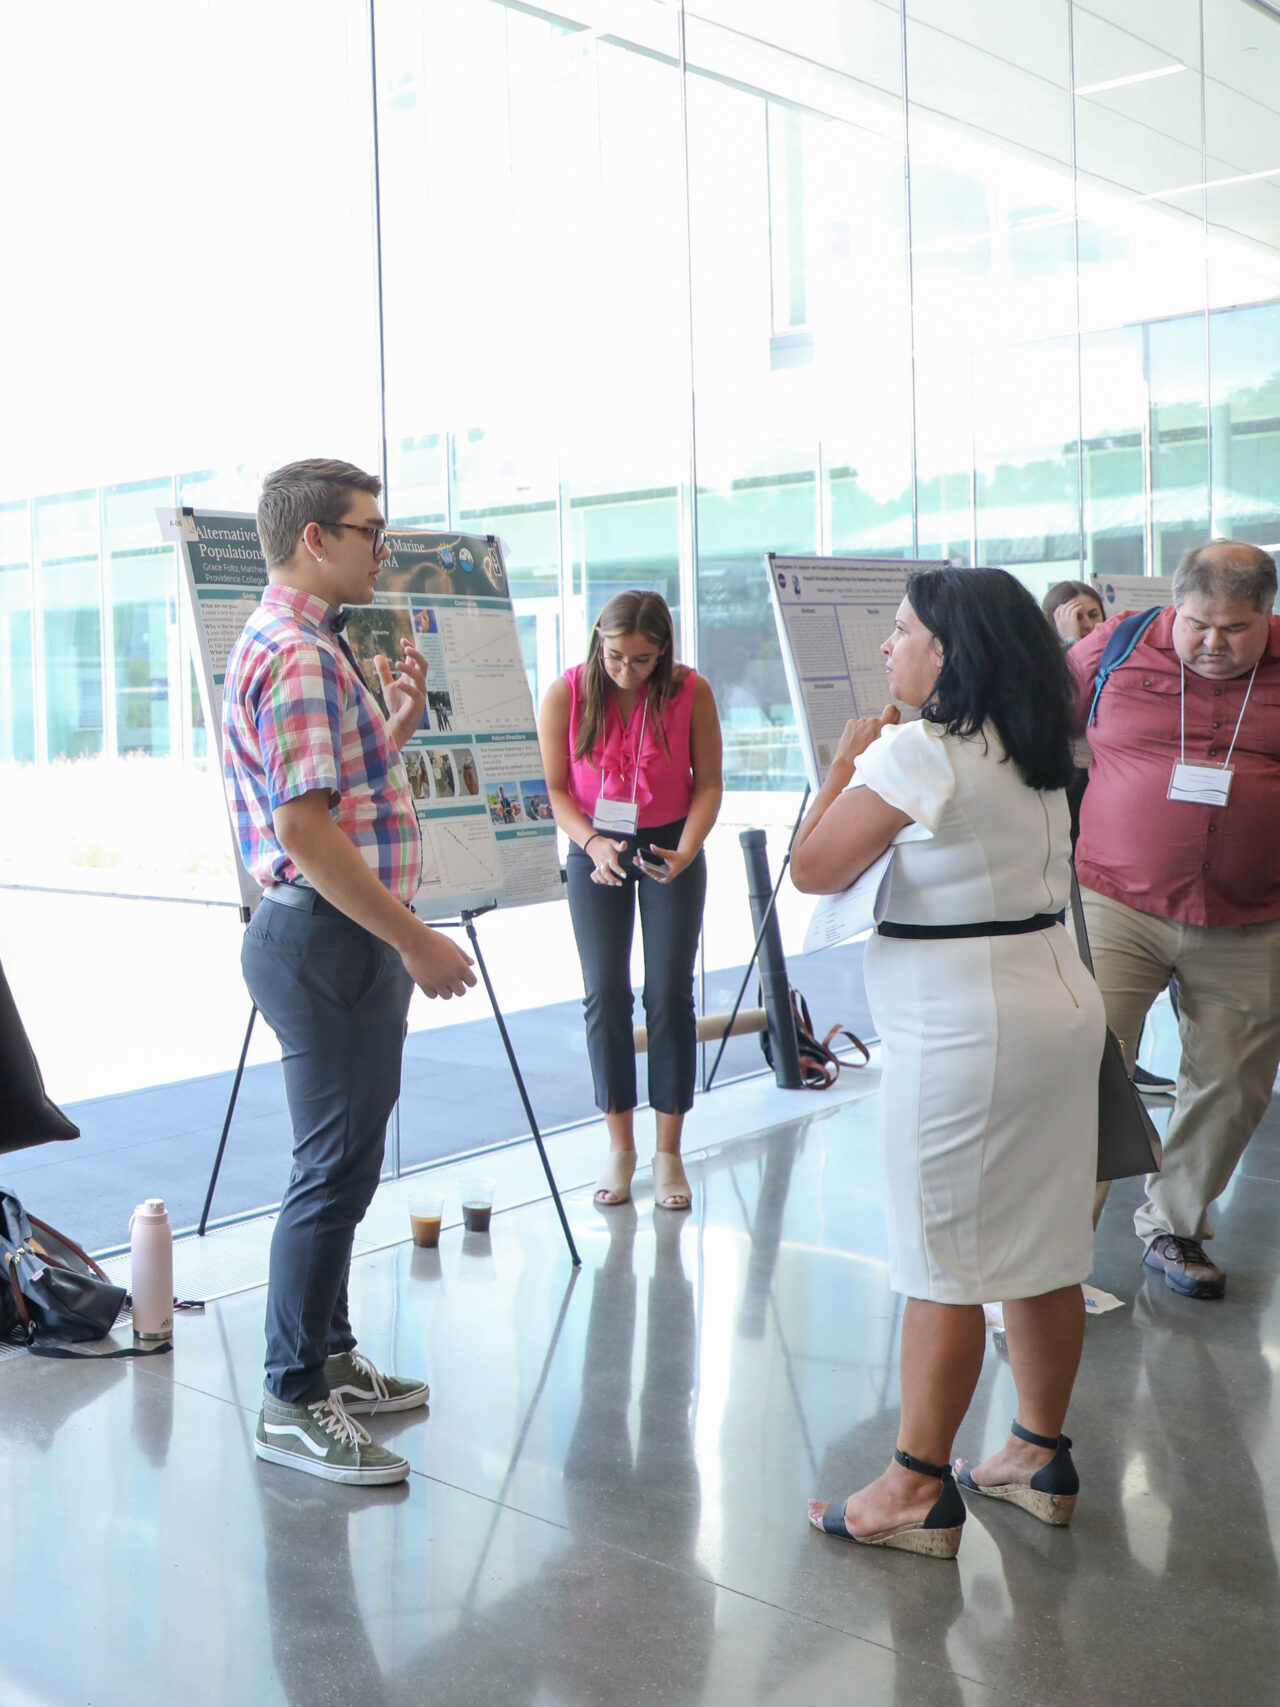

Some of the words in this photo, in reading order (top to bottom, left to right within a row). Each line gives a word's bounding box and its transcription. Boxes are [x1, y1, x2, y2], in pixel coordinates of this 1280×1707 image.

[196, 525, 257, 542] Alternative
[199, 544, 265, 561] Populations
[392, 539, 425, 552] Marine
[206, 574, 241, 582] Providence
[242, 576, 264, 585] College
